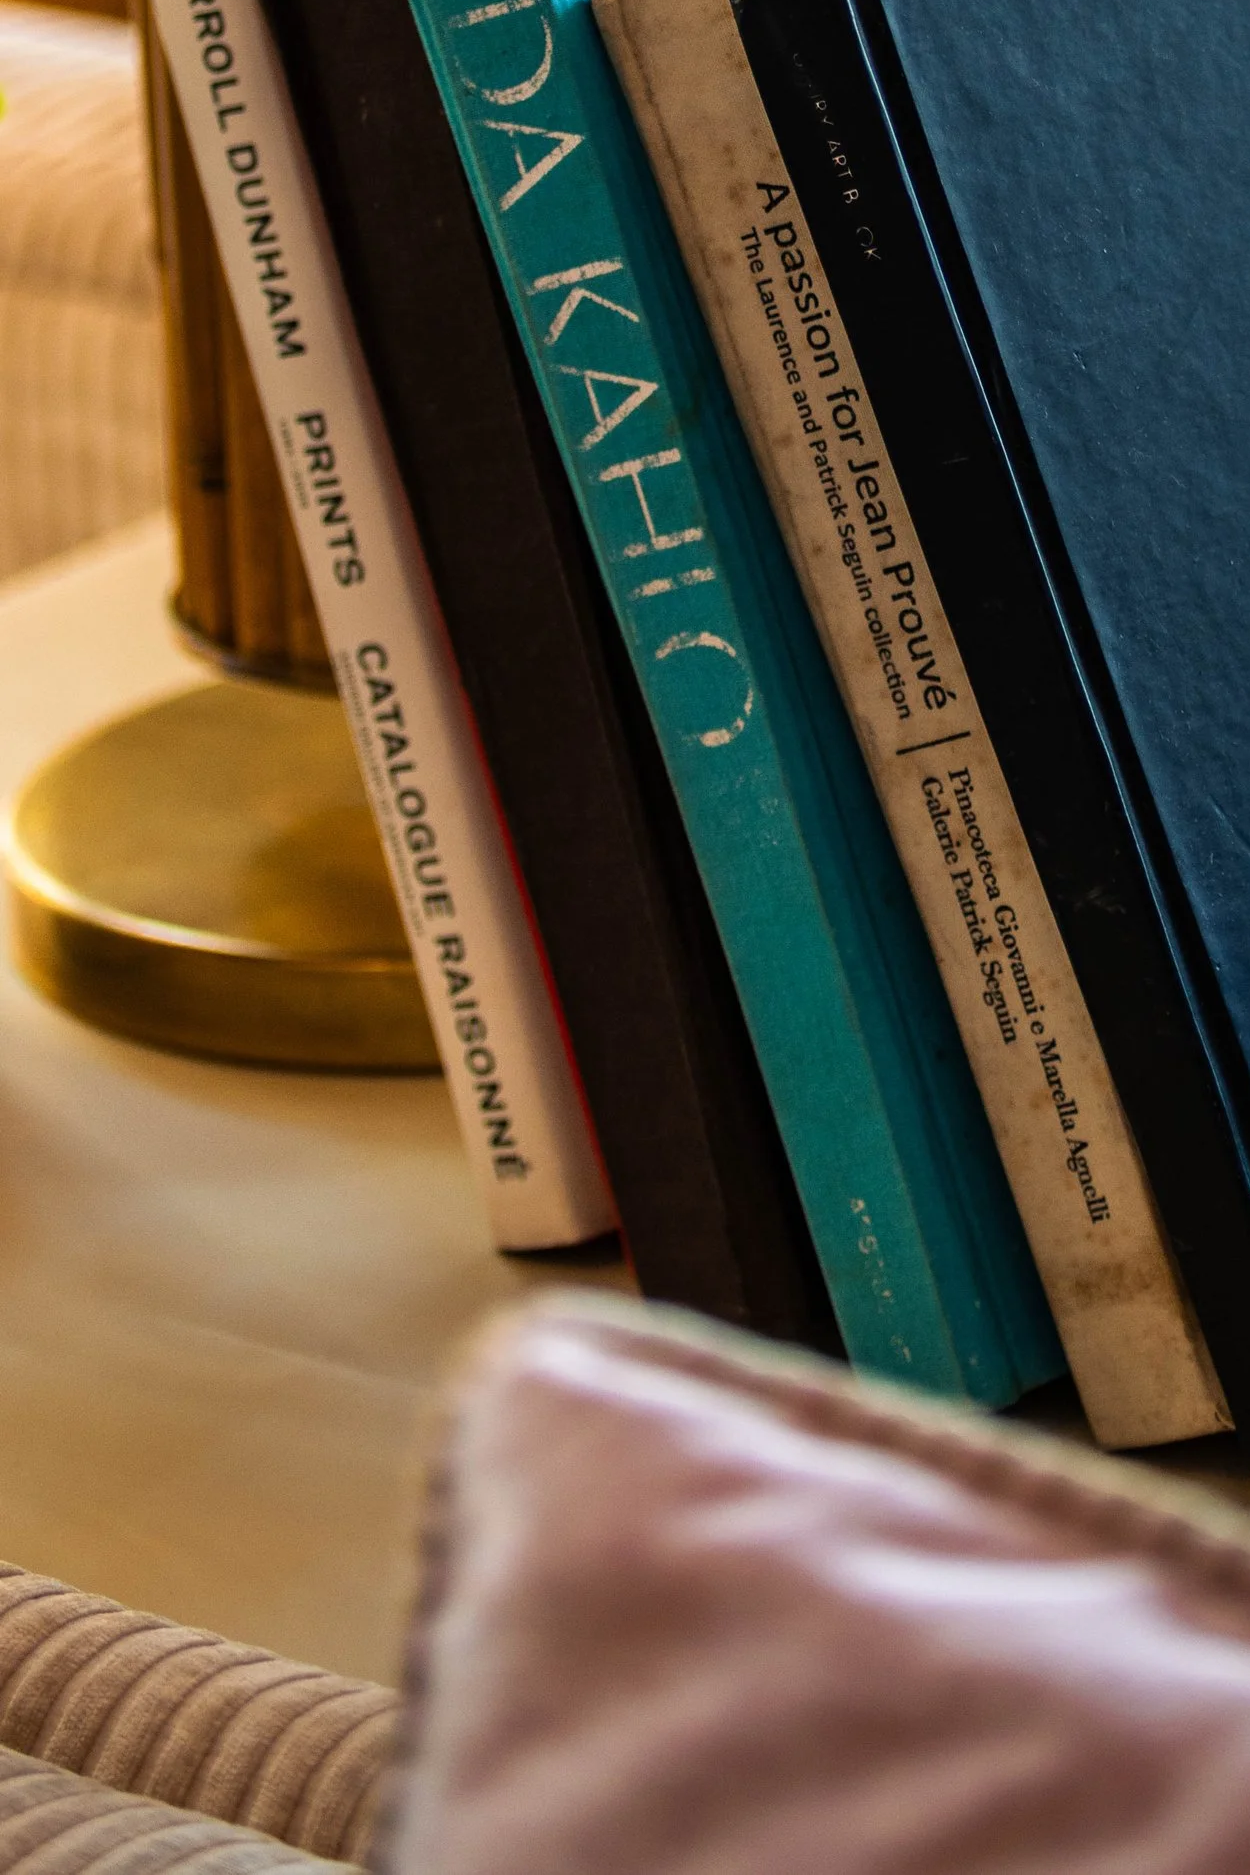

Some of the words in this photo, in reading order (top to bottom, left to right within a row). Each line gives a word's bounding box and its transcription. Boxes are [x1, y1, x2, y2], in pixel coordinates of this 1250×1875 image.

[757, 181, 791, 212] A
[827, 139, 853, 178] ART
[764, 220, 839, 378] passion
[826, 386, 864, 446] for
[741, 226, 764, 273] The
[756, 278, 801, 384] Laurence
[793, 390, 822, 434] and
[809, 439, 848, 519] Patrick
[838, 524, 872, 601] Seguin
[865, 608, 910, 720] collection
[848, 460, 895, 552] Jean
[227, 144, 306, 358] DUNHAM
[297, 410, 366, 588] PRINTS
[356, 642, 455, 916] CATALOGUE
[436, 933, 532, 1181] RAISONNÉ
[883, 561, 956, 710] Prouvé
[948, 767, 1000, 901] Pinacoteca
[922, 776, 961, 865] Galerie
[950, 869, 993, 956] Patrick
[980, 961, 1017, 1045] Seguin
[995, 905, 1044, 1015] Giovanni
[1031, 1021, 1044, 1035] e
[1036, 1038, 1078, 1133] Marella
[1066, 1139, 1110, 1224] Agnelli
